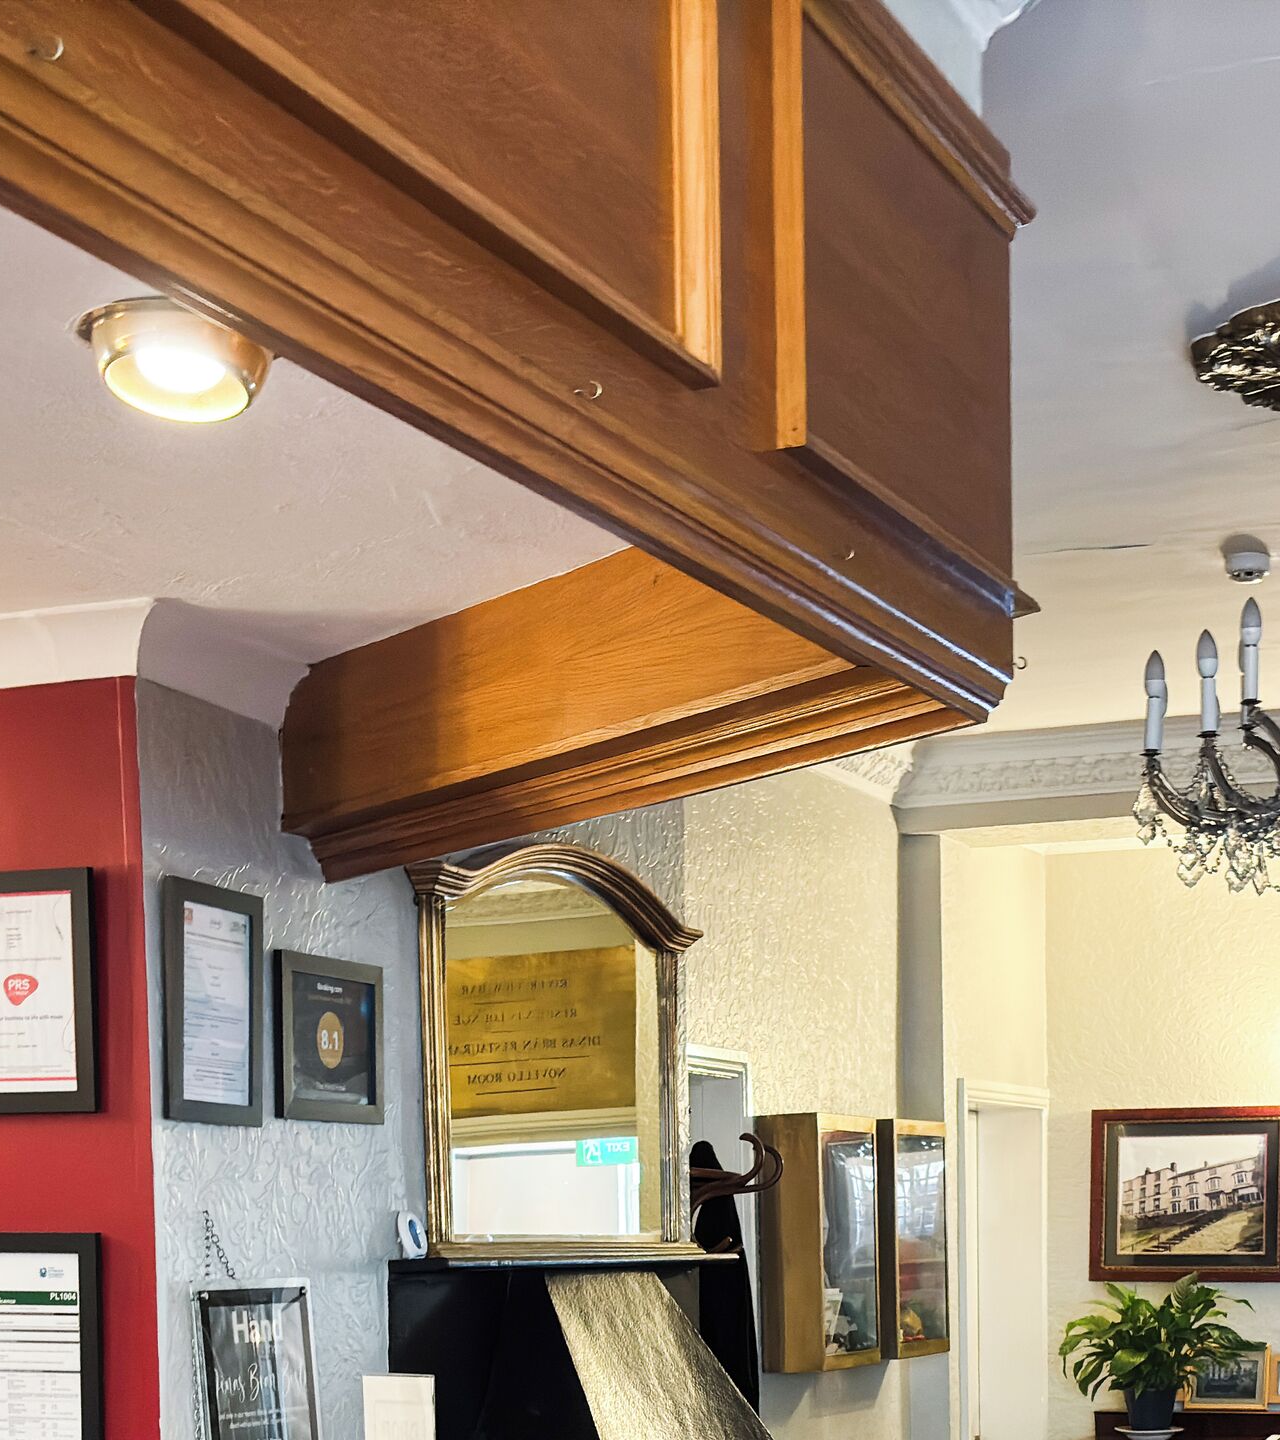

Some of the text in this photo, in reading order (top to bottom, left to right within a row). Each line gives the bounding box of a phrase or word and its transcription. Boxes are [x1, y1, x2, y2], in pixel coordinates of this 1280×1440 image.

[7, 978, 30, 991] PRS
[321, 1029, 339, 1050] 8.1
[231, 1308, 283, 1344] Hand
